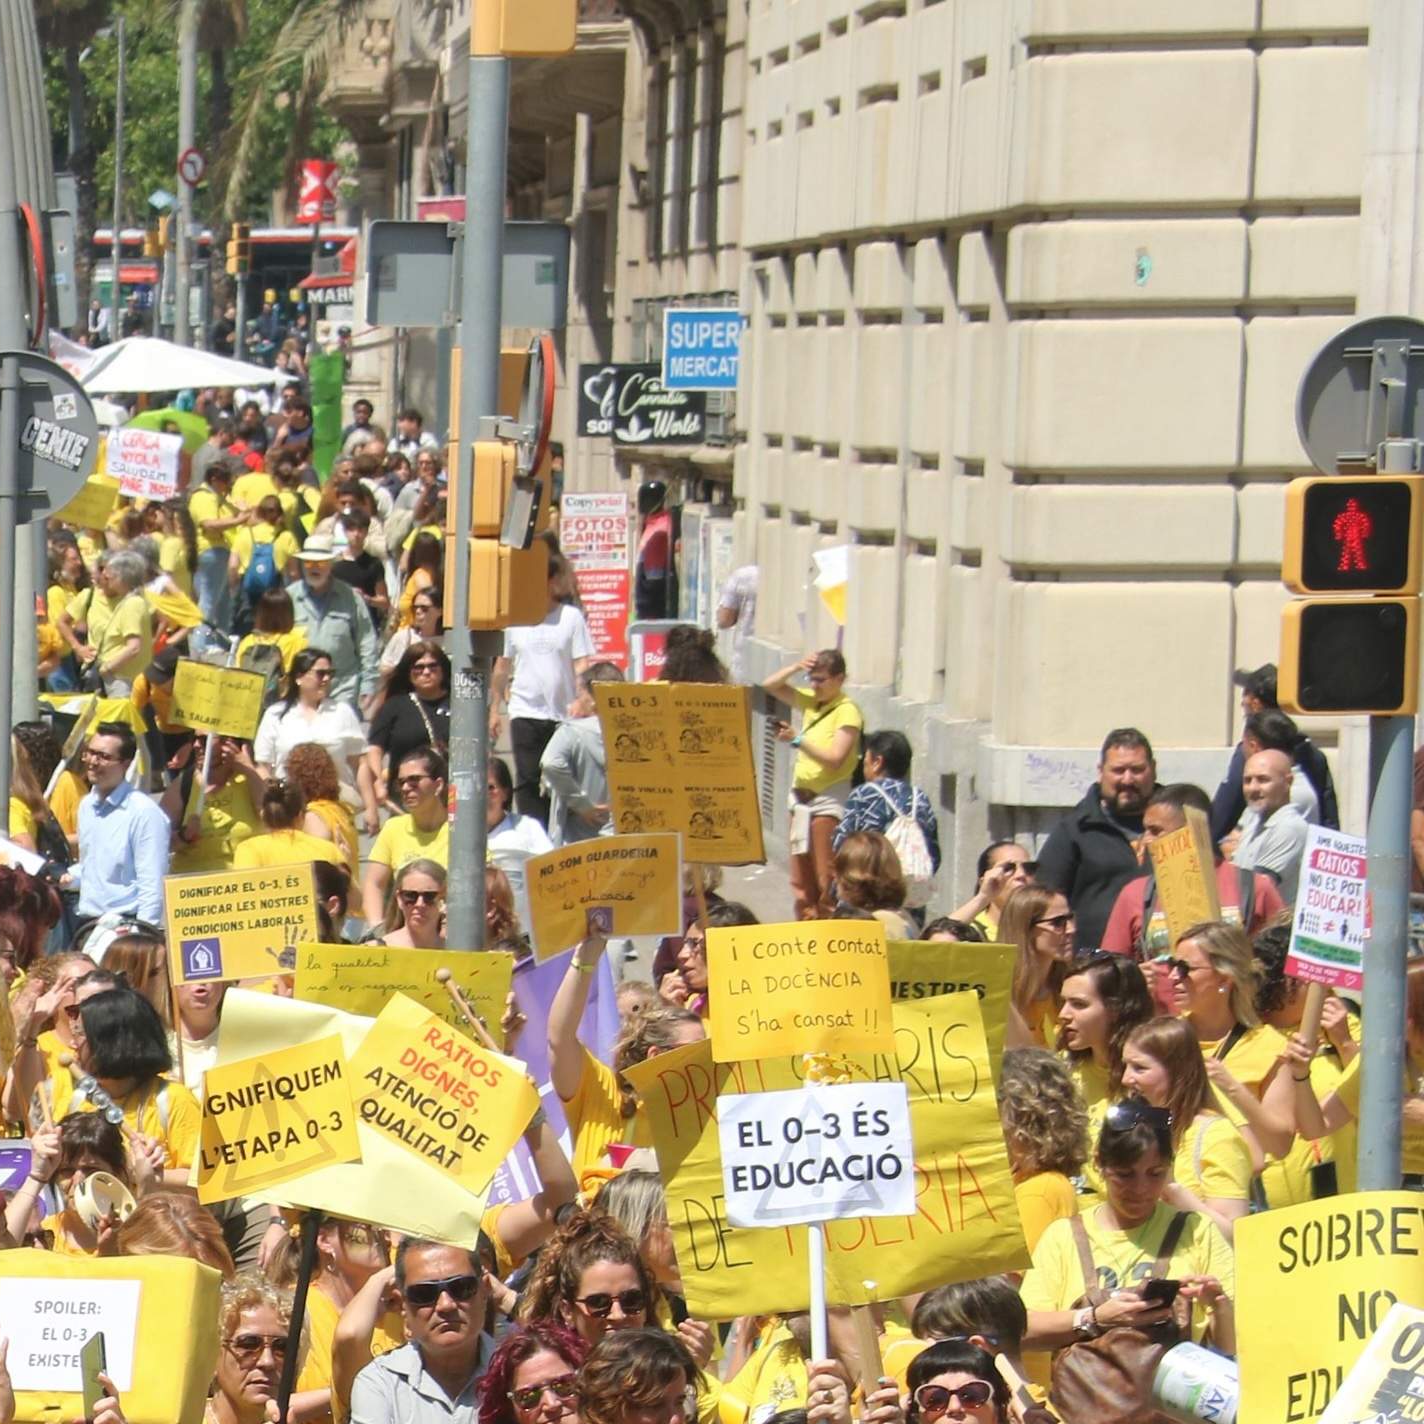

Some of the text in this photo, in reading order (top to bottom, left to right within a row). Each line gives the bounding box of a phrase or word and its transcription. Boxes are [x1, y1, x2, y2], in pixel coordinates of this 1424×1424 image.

[670, 357, 738, 378] MERCAT
[649, 410, 700, 438] World
[562, 532, 625, 543] CARNET
[563, 518, 626, 531] FOTOS
[608, 697, 629, 709] EL
[539, 847, 659, 877] NO SOM GUARDERIA
[173, 893, 309, 919] DIGNIFICAR LES NOSTRES
[1307, 889, 1361, 917] EDUCAR!
[181, 913, 304, 936] CONDICIONS LABORALS
[731, 934, 887, 961] i conte contat,
[728, 968, 862, 996] LA DOCÈNCIA
[423, 1023, 502, 1089] RÀTIOS
[364, 1065, 489, 1153] ATENCIÓ DE
[359, 1097, 462, 1171] QUALITAT
[737, 1101, 890, 1148] EL 0-3 ÉS
[202, 1110, 344, 1171] L'ETAPA 0-3
[731, 1143, 903, 1193] EDUCACIÓ
[33, 1299, 103, 1317] SPOILER:
[42, 1325, 89, 1341] EL 0-3
